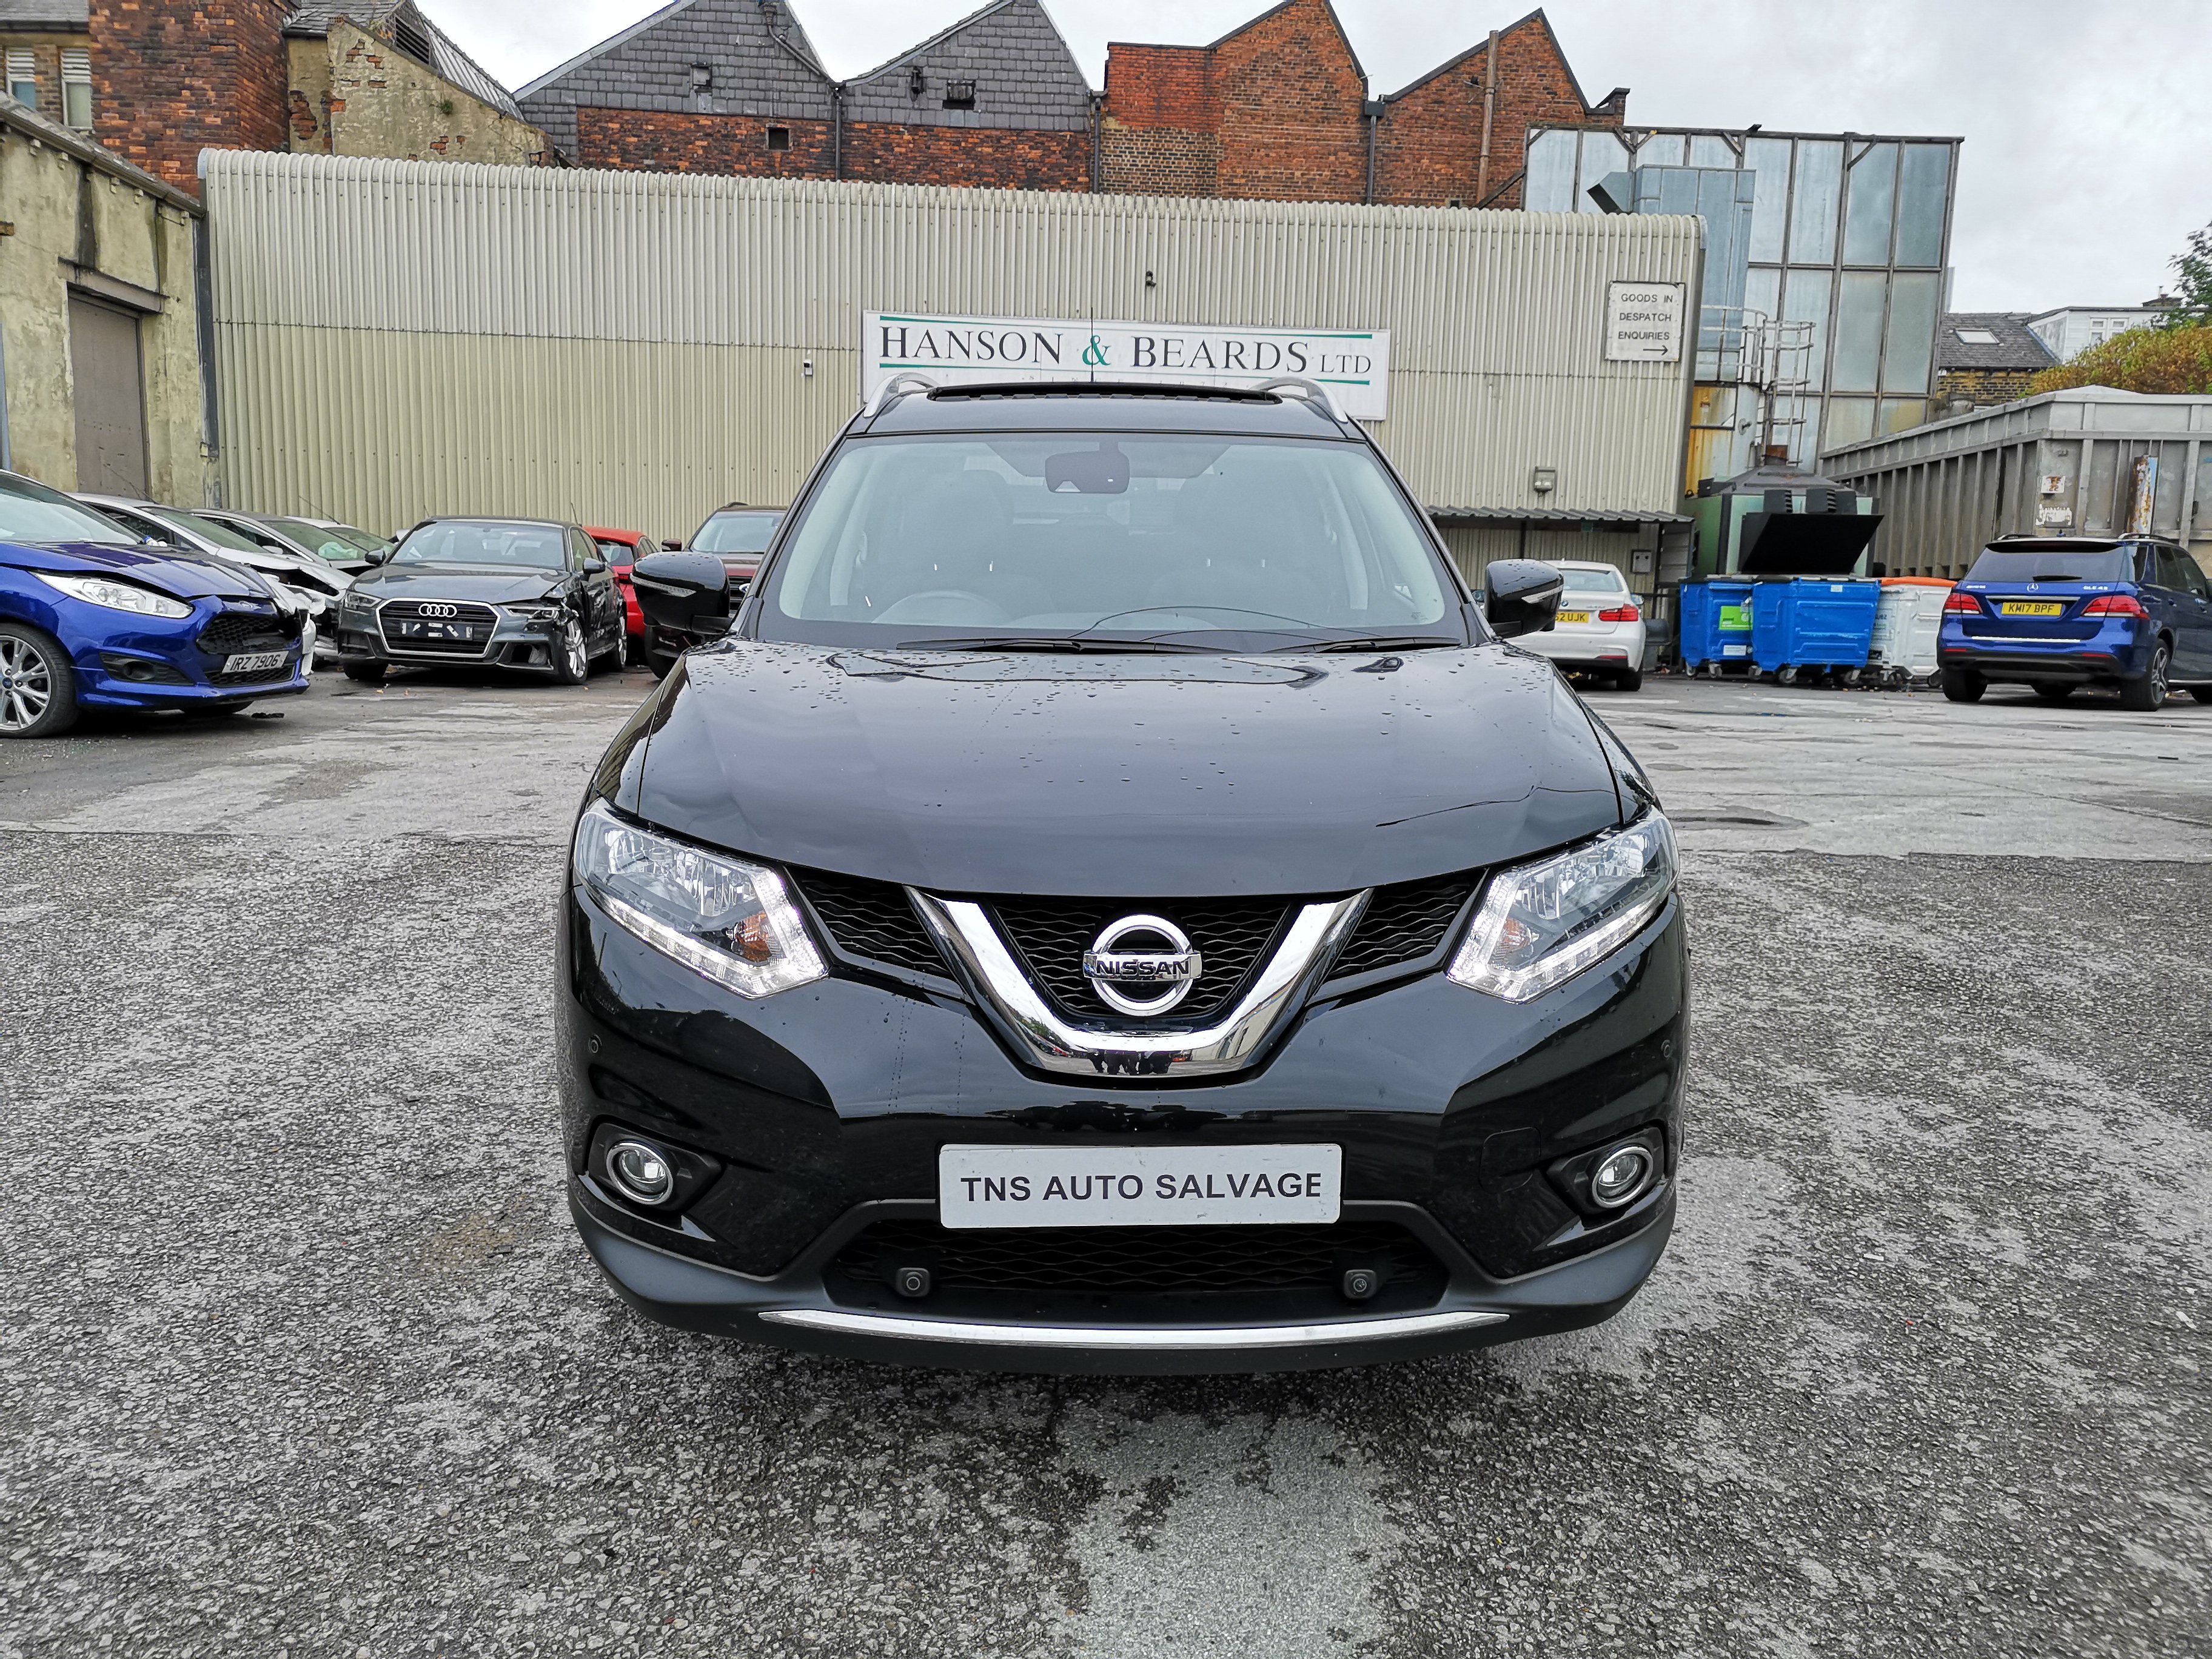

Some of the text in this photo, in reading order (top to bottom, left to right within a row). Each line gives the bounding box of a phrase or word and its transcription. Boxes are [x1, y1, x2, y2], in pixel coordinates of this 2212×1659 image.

[1621, 293, 1673, 303] GOODS IN
[1619, 312, 1672, 321] DESPATCH
[1618, 331, 1670, 340] ENQUIRIES
[880, 326, 1372, 374] HANSON & BEARDS LTD
[2008, 603, 2055, 614] KM17 BPF
[1567, 613, 1585, 622] UJK
[230, 654, 280, 671] IRZ 7906
[1096, 960, 1189, 975] NISSAN
[960, 1173, 1322, 1202] TNS AUTO SALVAGE
